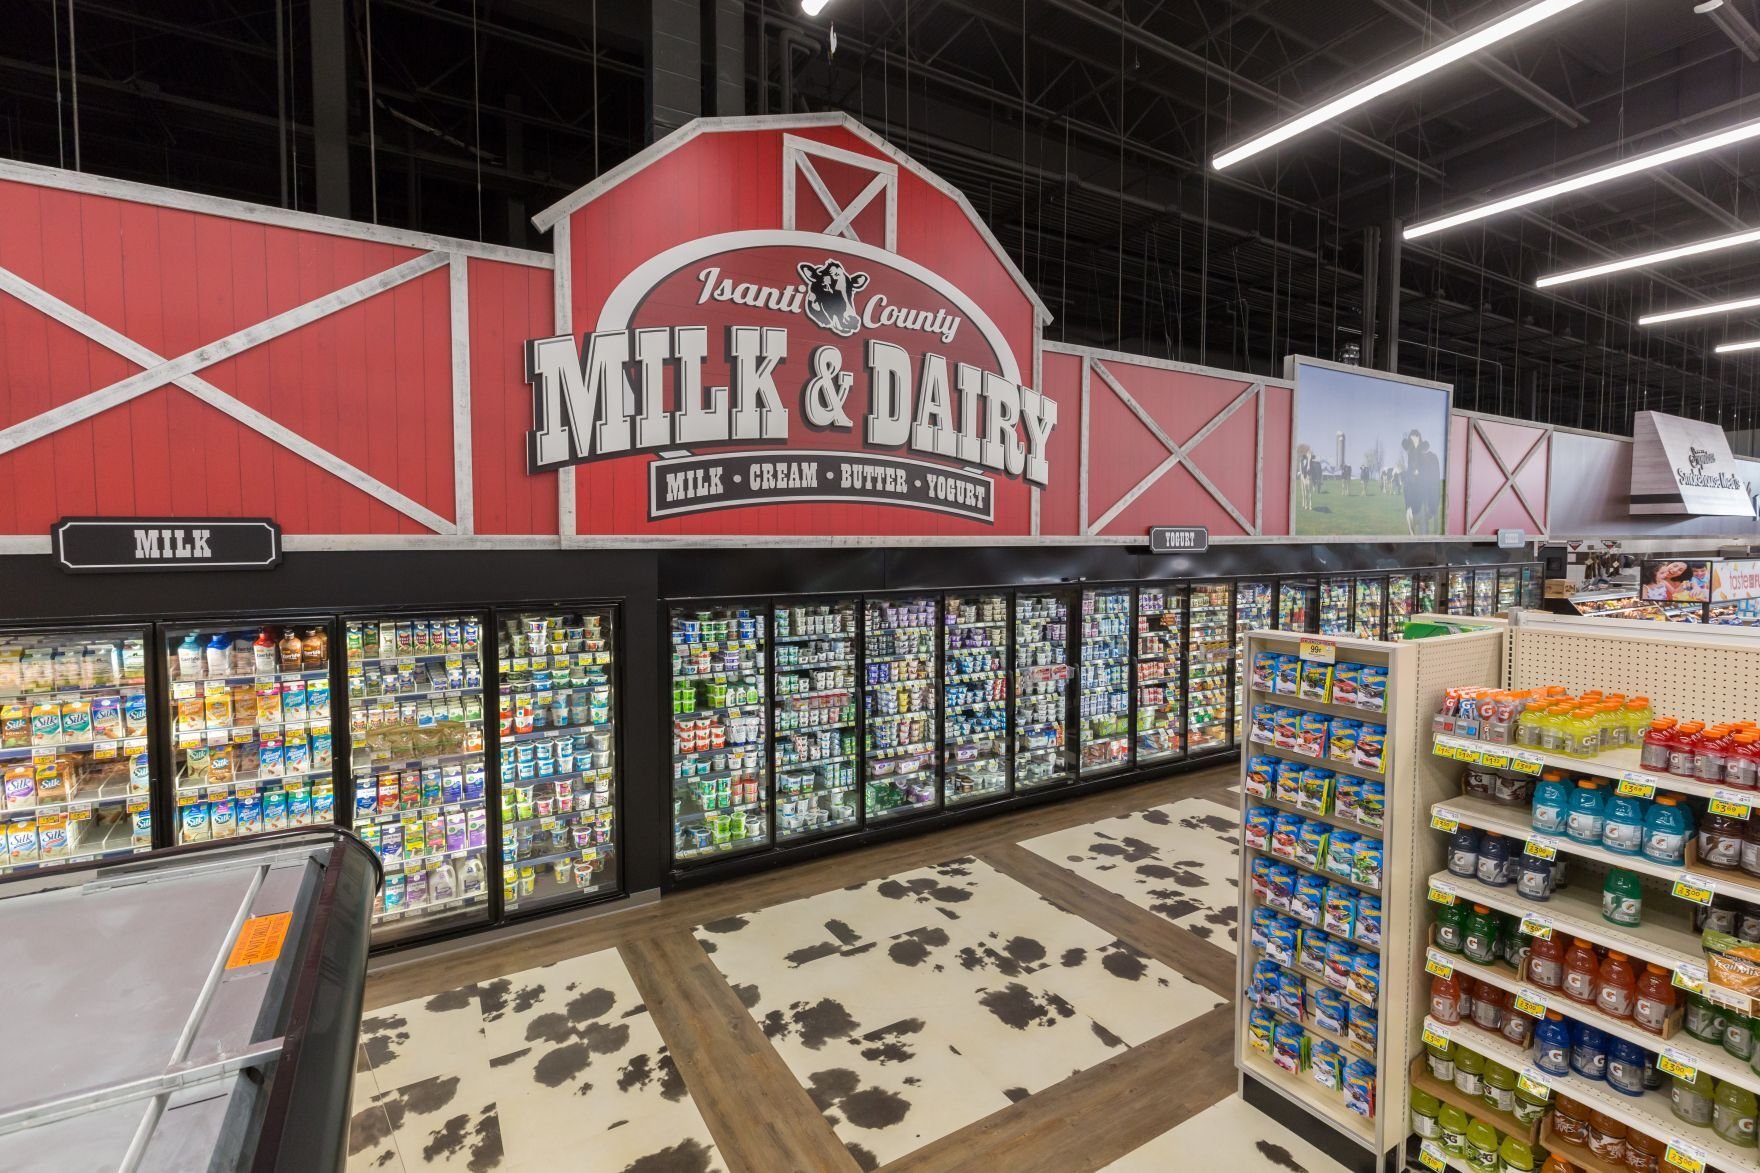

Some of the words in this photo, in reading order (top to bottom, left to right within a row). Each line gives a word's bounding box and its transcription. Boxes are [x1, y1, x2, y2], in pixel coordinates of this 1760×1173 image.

[697, 265, 802, 316] Isanti
[862, 293, 961, 344] County
[533, 324, 789, 468] MILK
[805, 344, 854, 428] &
[867, 338, 1058, 486] DAIRY
[665, 466, 725, 502] MILK
[749, 462, 818, 491] CREAM
[840, 463, 909, 494] BUTTER
[926, 473, 986, 510] YOGURT
[134, 528, 213, 559] MILK
[1165, 531, 1195, 547] YOGURT
[64, 712, 89, 726] Silk
[96, 710, 118, 720] Silk
[5, 719, 26, 731] Silk
[34, 716, 57, 729] Silk
[190, 750, 207, 760] Silk
[211, 759, 228, 769] Silk
[7, 780, 31, 792] Silk
[40, 778, 60, 790] Silk
[187, 816, 205, 827] Silk
[213, 814, 232, 824] Silk
[10, 833, 33, 847] Silk
[42, 830, 65, 844] Silk
